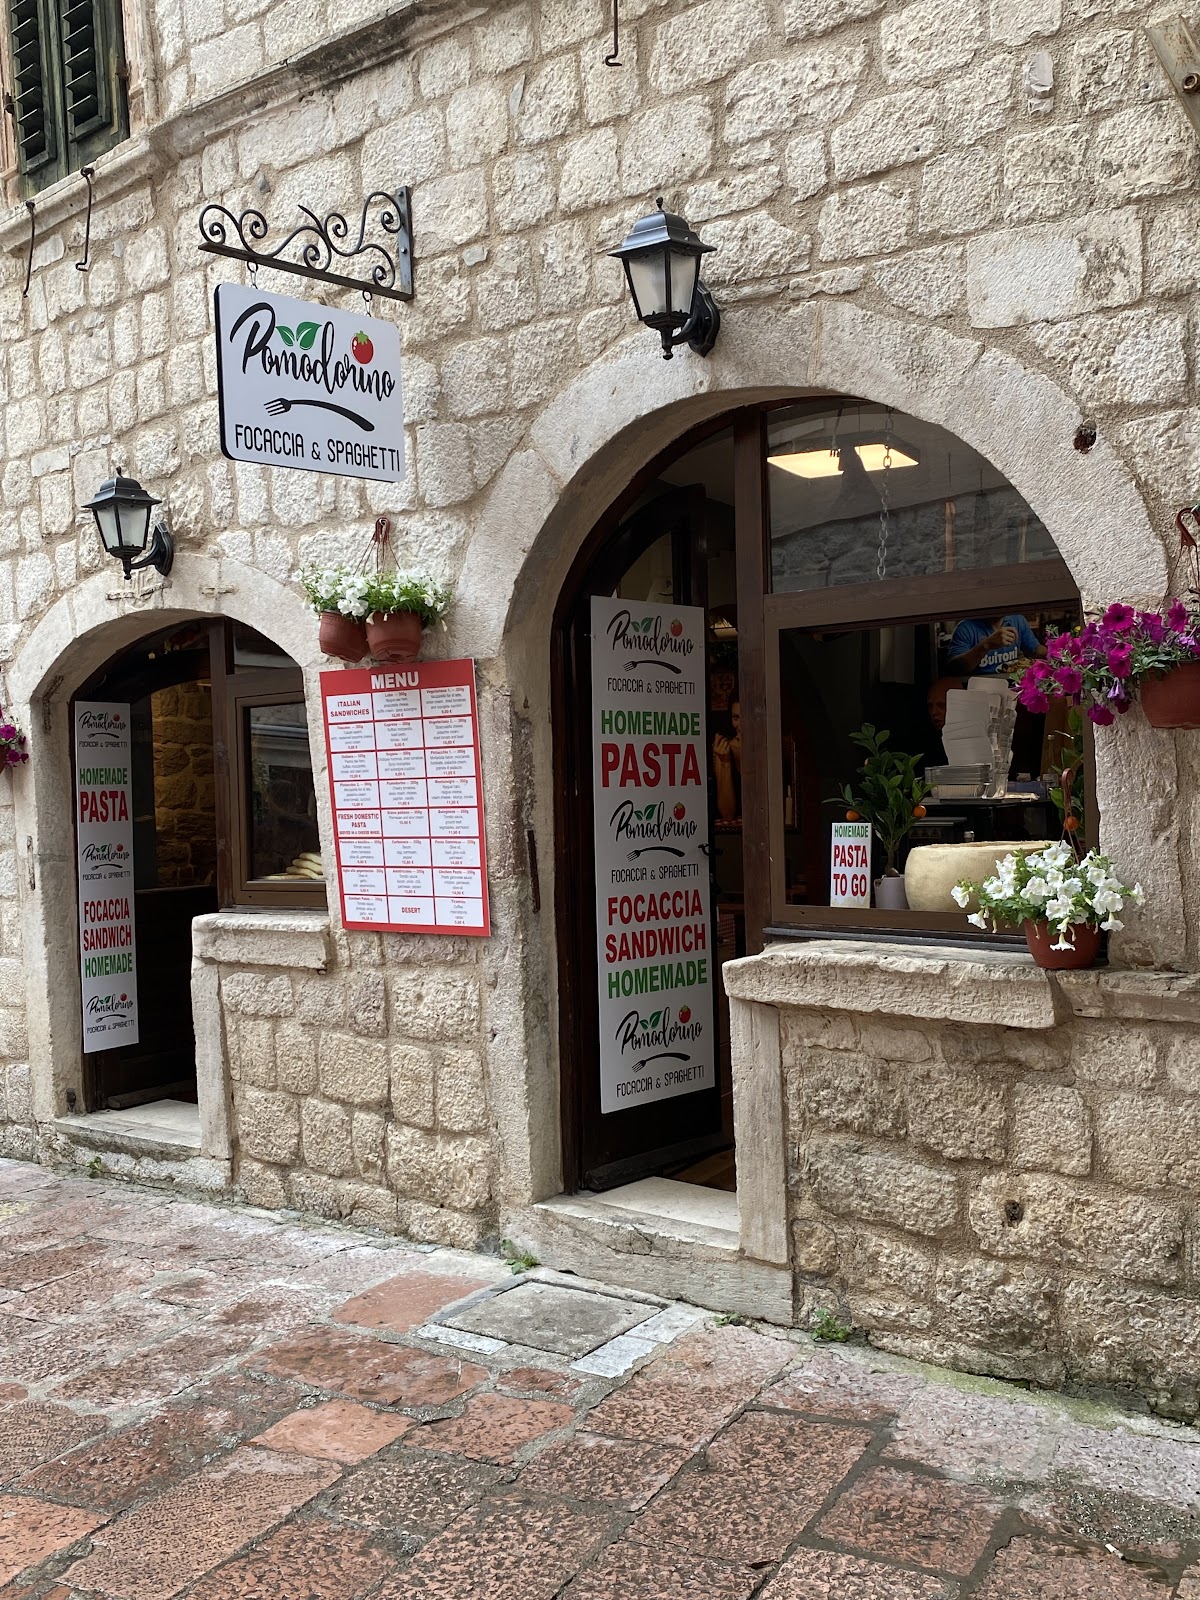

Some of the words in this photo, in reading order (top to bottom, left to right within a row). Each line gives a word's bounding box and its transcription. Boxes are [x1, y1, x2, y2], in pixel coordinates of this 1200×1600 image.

[229, 302, 396, 401] Pomodorino
[234, 424, 305, 458] FOCACCIA
[311, 441, 321, 461] &
[327, 438, 400, 472] SPAGHETTI
[606, 609, 694, 656] Pomodorino
[370, 671, 419, 690] MENU
[607, 677, 644, 693] FOCACCIA
[646, 683, 652, 694] &
[655, 680, 695, 695] SPAGHETTI
[330, 708, 370, 718] SANDWICHES
[337, 700, 361, 708] ITALIAN
[78, 710, 126, 731] Pomodorino
[601, 709, 700, 736] HOMEMADE
[79, 740, 98, 748] FOCACCIA
[79, 768, 128, 786] HOMEMADE
[601, 742, 702, 788] PASTA
[80, 790, 128, 823] PASTA
[609, 799, 698, 842] Pomodorino
[834, 825, 869, 838] HOMEMADE
[82, 844, 130, 863] Pomodorino
[833, 844, 868, 868] PASTA
[82, 872, 102, 881] FOCACCIA
[108, 870, 130, 880] SPAGHETTI
[611, 867, 648, 884] FOCACCIA
[650, 869, 656, 880] &
[658, 863, 699, 880] SPAGHETTI
[833, 873, 848, 897] TO
[851, 873, 867, 897] GO
[84, 898, 130, 924] FOCACCIA
[607, 889, 703, 926] FOCACCIA
[83, 924, 132, 952] SANDWICH
[605, 923, 706, 963] SANDWICH
[85, 952, 133, 978] HOMEMADE
[607, 958, 708, 999] HOMEMADE
[86, 1024, 106, 1034] FOCACCIA
[112, 1020, 134, 1030] SPAGHETTI
[615, 1006, 703, 1055] Pomodorino
[616, 1076, 653, 1098] FOCACCIA
[655, 1078, 662, 1089] &
[664, 1064, 705, 1086] SPAGHETTI
